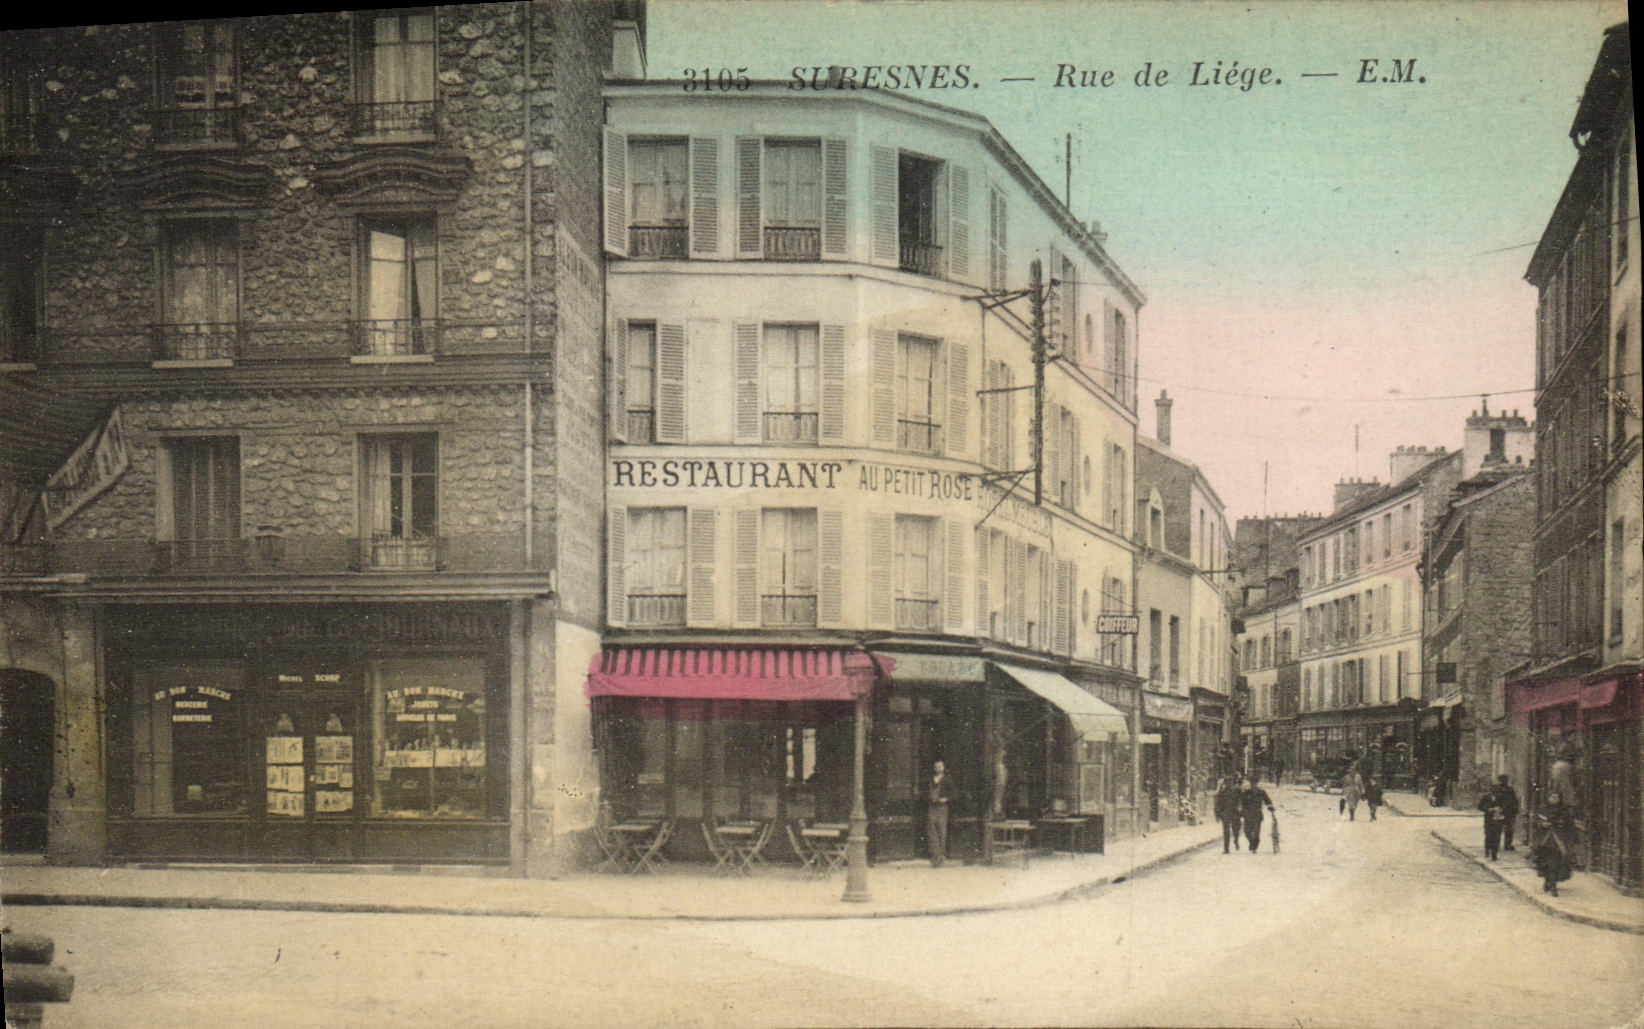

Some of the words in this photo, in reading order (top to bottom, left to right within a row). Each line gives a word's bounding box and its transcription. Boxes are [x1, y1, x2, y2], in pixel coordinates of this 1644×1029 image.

[612, 460, 843, 489] RESTAURANT
[860, 464, 878, 492] AU
[928, 469, 973, 502] ROSE
[1098, 617, 1138, 633] COIFFEUR
